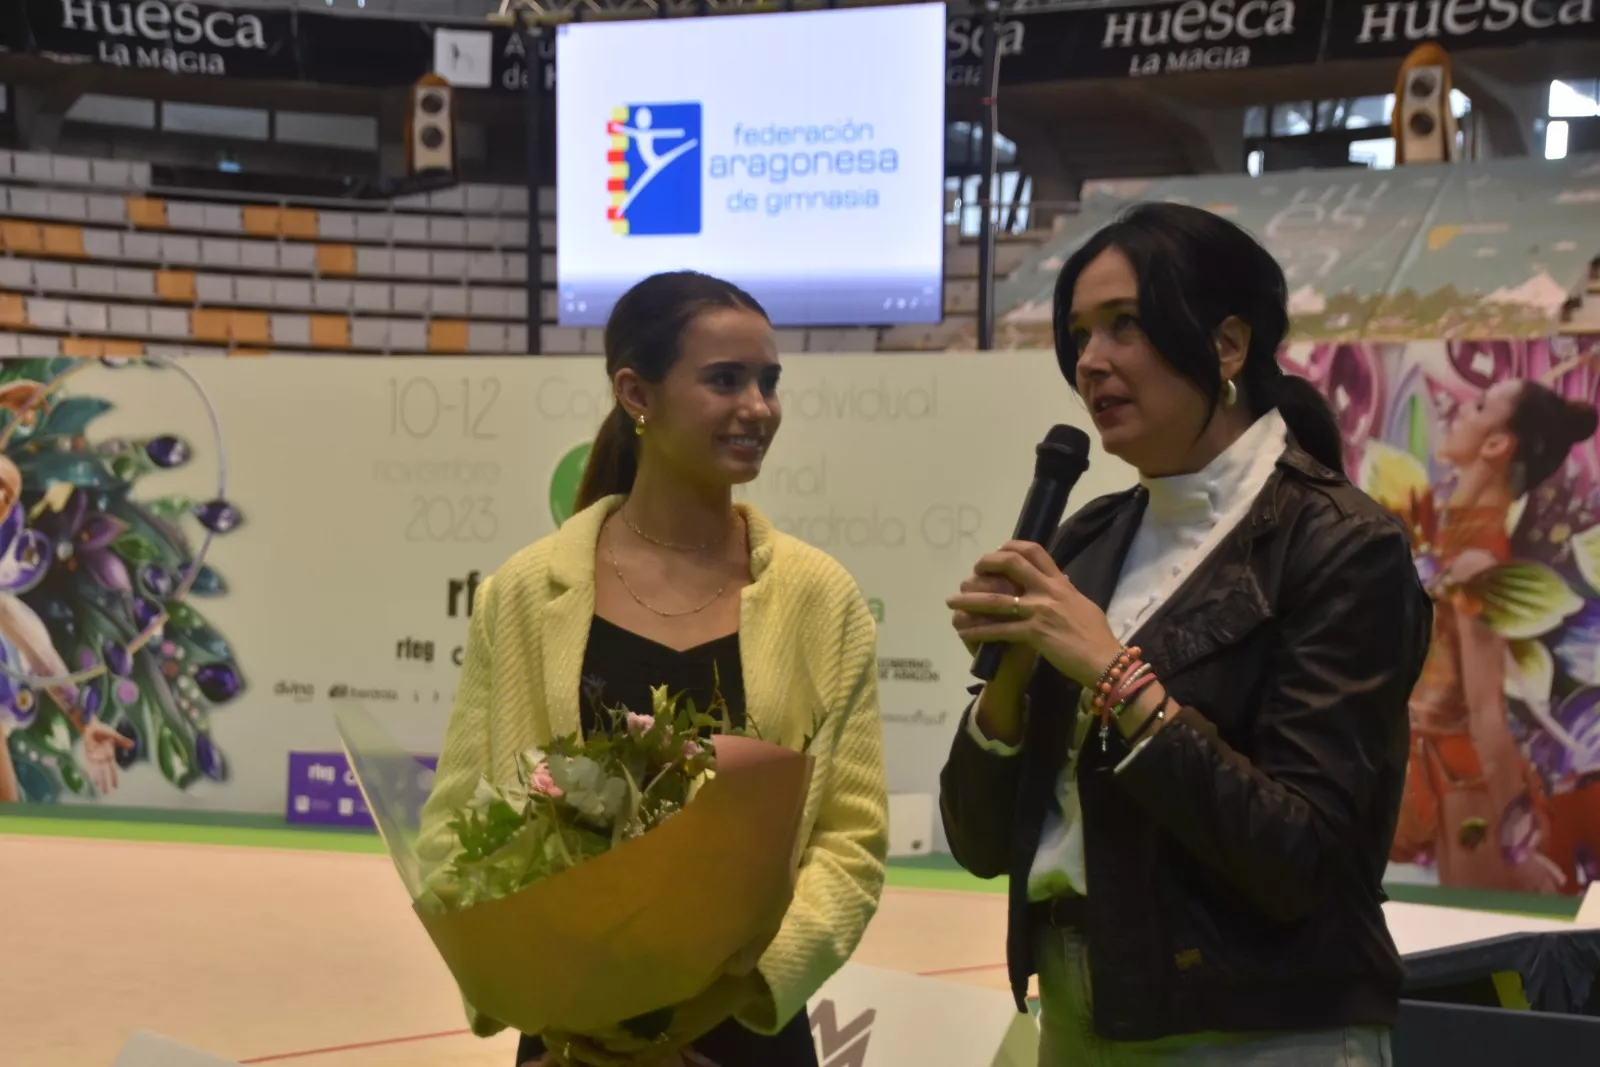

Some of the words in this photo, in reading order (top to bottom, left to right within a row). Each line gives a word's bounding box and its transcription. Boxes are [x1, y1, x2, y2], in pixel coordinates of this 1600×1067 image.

[61, 0, 267, 48] Huesca
[1101, 0, 1296, 48] Huesca
[733, 117, 875, 147] federación
[708, 148, 899, 184] aragonesa
[726, 189, 759, 213] de
[764, 188, 881, 217] gimnasia
[388, 376, 502, 440] 10-12
[404, 493, 499, 543] 2023
[919, 502, 985, 551] GR
